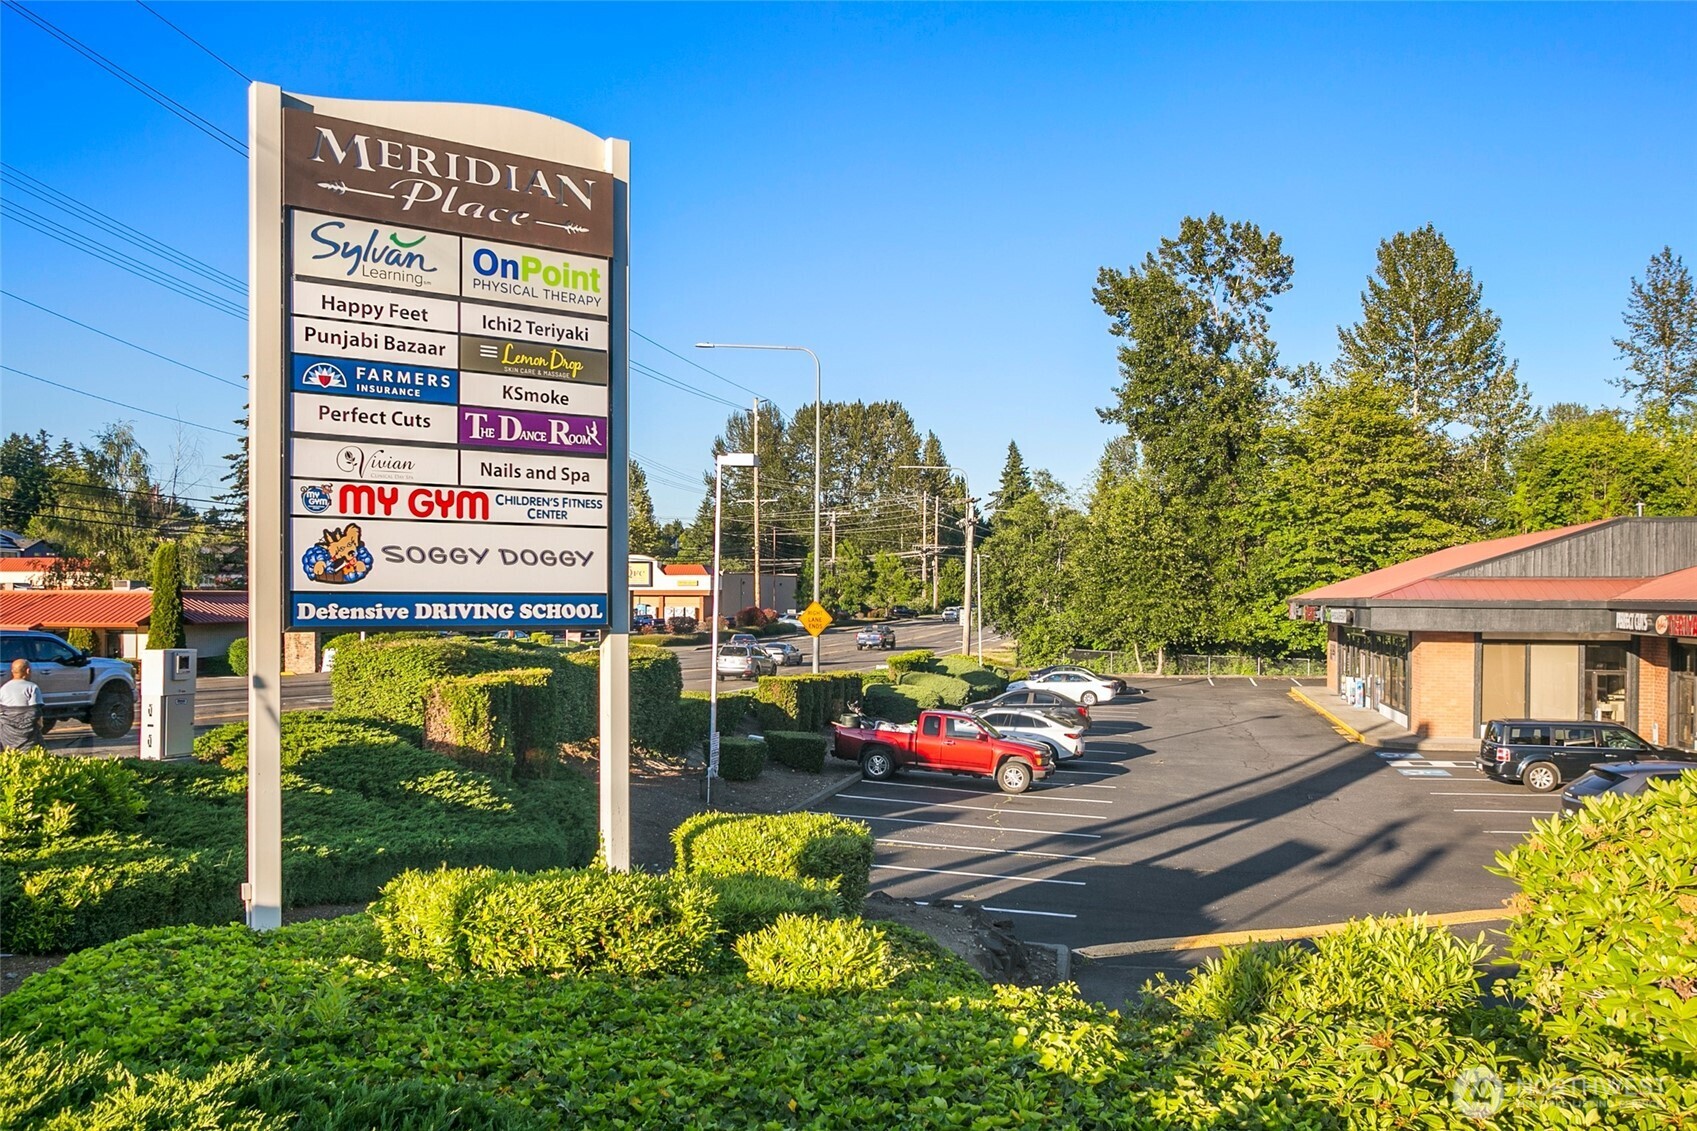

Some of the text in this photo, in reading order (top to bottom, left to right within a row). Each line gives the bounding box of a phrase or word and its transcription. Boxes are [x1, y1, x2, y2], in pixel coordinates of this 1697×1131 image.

[311, 126, 596, 211] MERIDIAN
[389, 178, 530, 226] Place
[310, 221, 438, 276] Sylvan
[362, 264, 423, 288] Learning
[472, 248, 601, 294] OnPoint
[472, 278, 602, 307] PHYSICAL THERAPY
[321, 295, 429, 322] Happy Feet
[304, 326, 446, 356] Punjabi Bazaar
[482, 315, 589, 342] Ichi2 Teriyaki
[501, 343, 584, 378] Lemon Drop
[355, 366, 451, 388] FARMERS
[543, 370, 571, 379] MASSAGE
[356, 383, 421, 397] INSURANCE
[502, 385, 569, 406] KSmoke
[318, 405, 432, 429] Perfect Cuts
[336, 445, 415, 478] Vivian
[480, 461, 591, 485] Nails and Spa
[338, 484, 490, 521] MY GYM
[495, 493, 603, 510] CHILDREN'S FITNESS
[526, 508, 568, 520] CENTER
[381, 545, 595, 568] SOGGY DOGGY
[297, 602, 603, 620] Defensive DRIVING SCHOOL
